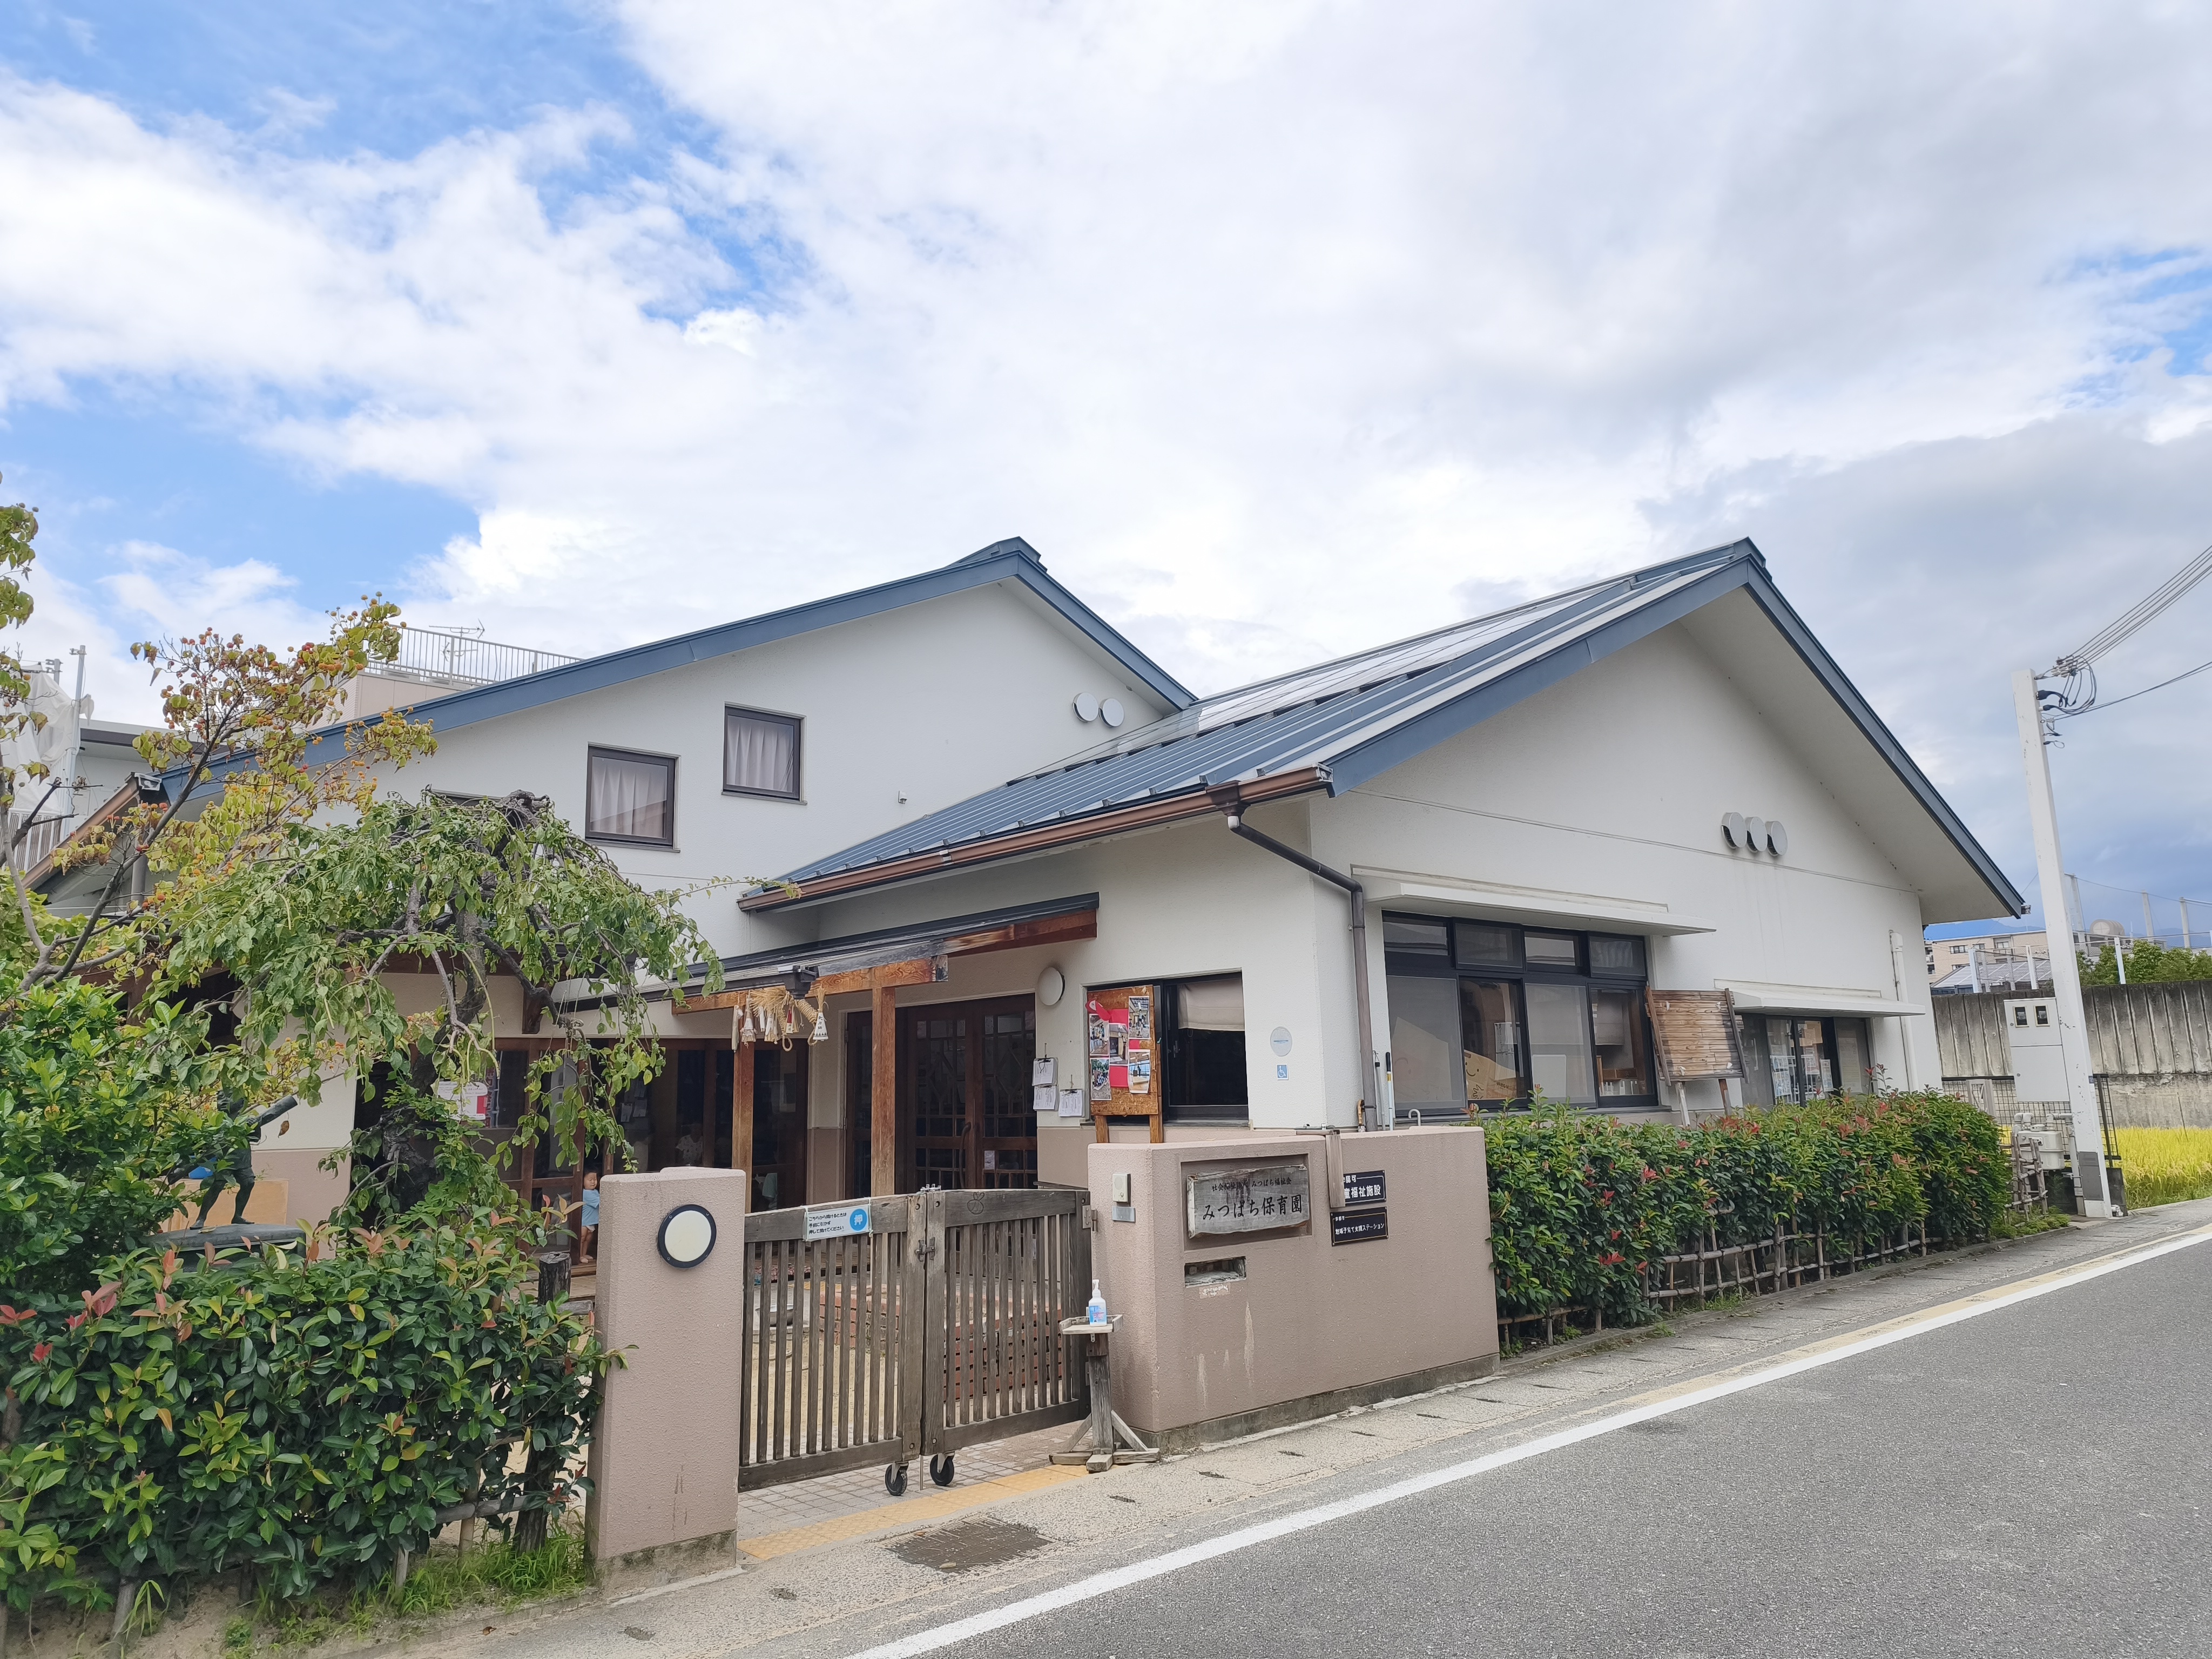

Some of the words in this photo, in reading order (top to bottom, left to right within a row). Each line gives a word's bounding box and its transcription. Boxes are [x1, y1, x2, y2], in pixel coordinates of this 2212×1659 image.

[1251, 1176, 1292, 1188] みつばち福祉会
[1203, 1194, 1302, 1220] みつばち保育園
[808, 1212, 847, 1222] こちらから開けるときは
[854, 1214, 863, 1226] 押
[808, 1226, 844, 1235] 押して開けてください
[1335, 1223, 1384, 1235] 地域子育て支援ステーション
